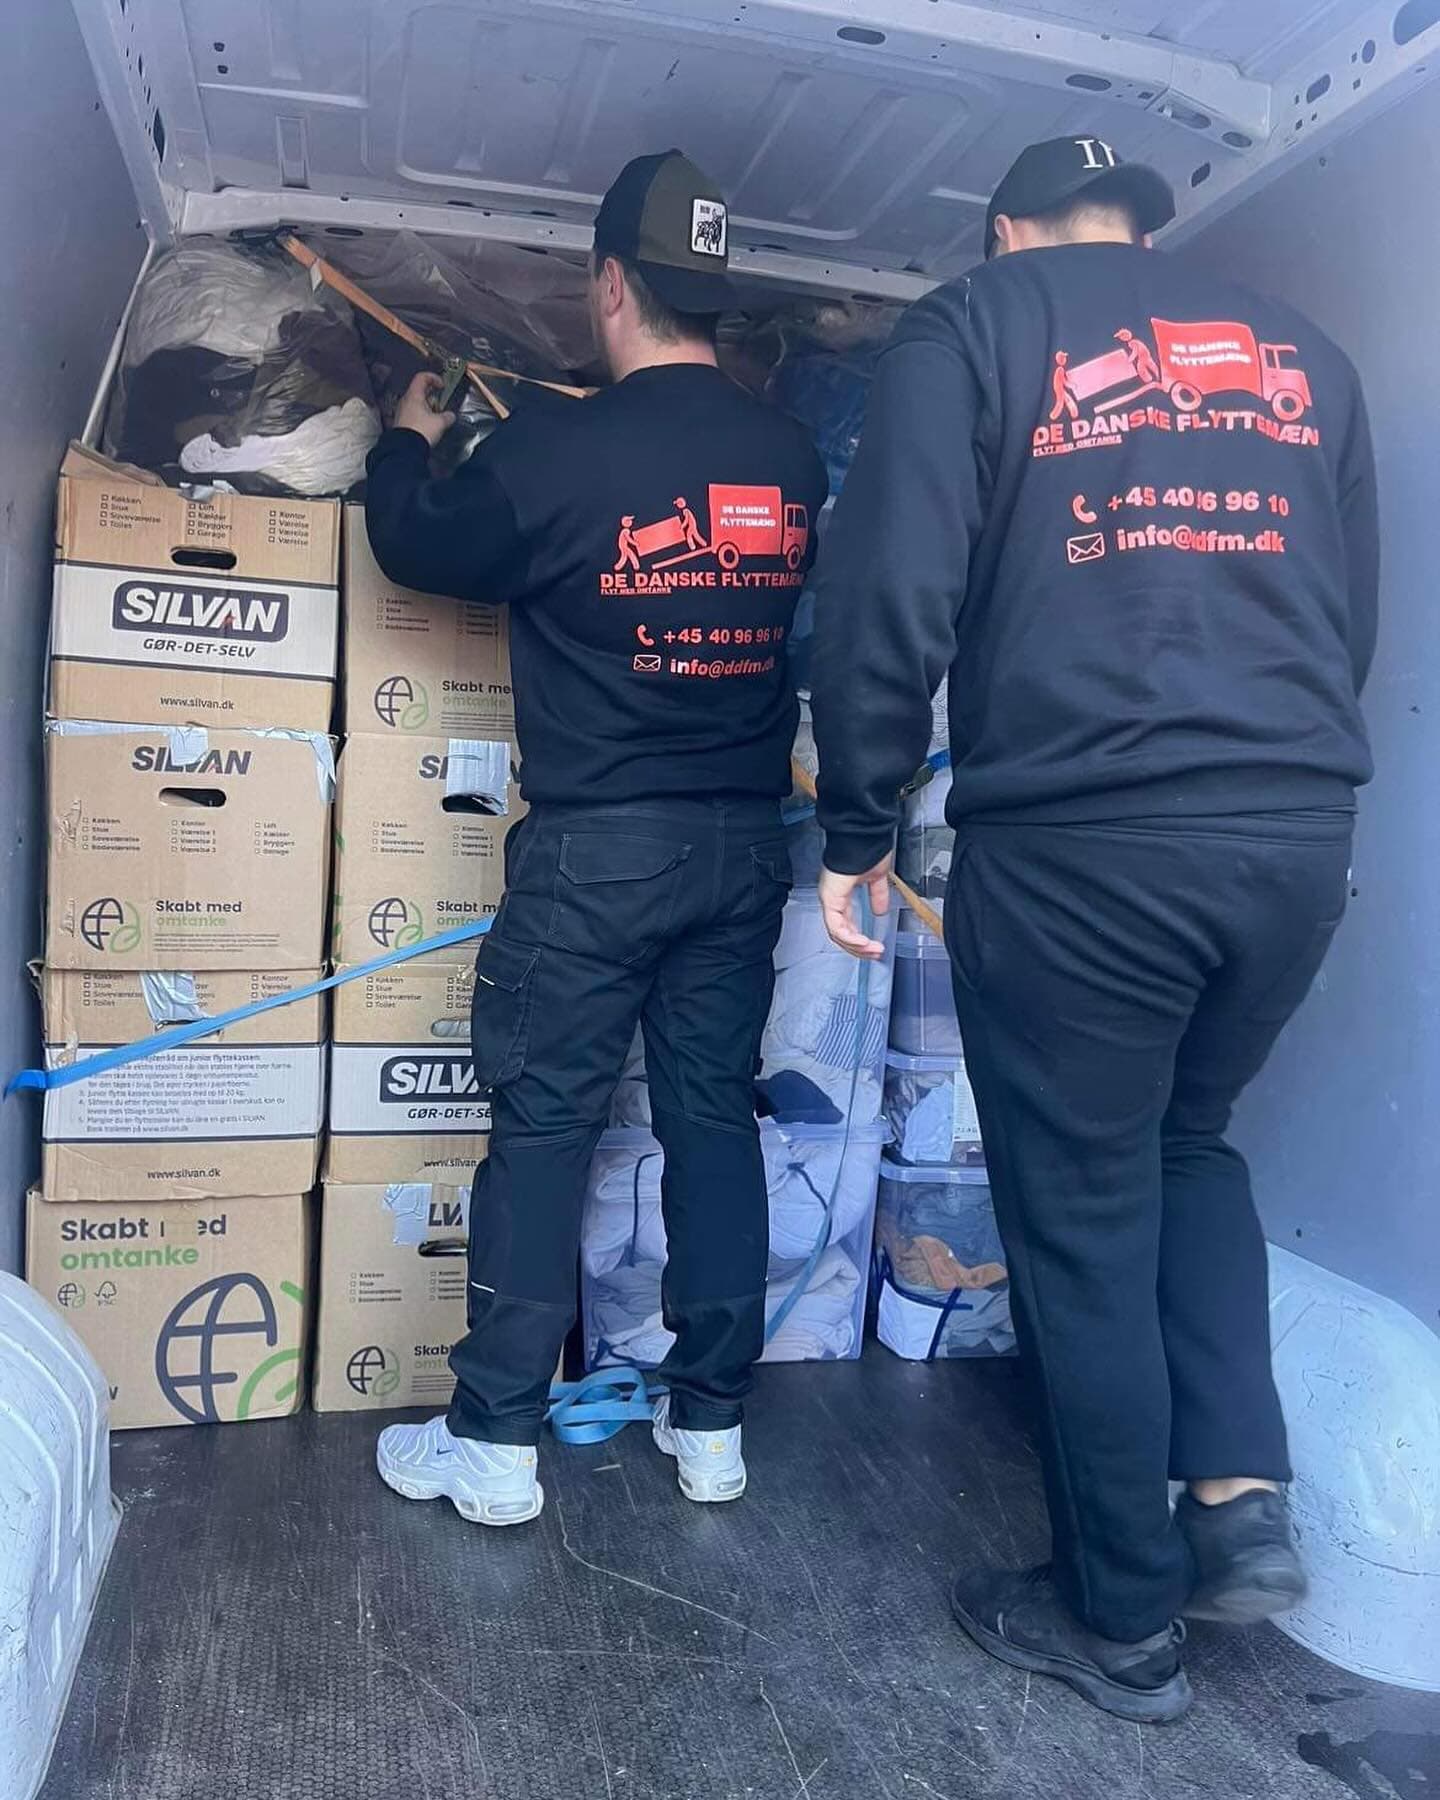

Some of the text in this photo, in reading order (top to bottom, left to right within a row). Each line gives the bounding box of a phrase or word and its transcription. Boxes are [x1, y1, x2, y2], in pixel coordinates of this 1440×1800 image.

[1033, 406, 1319, 446] DE DANSKE FLYTTEMÆN
[1107, 486, 1156, 511] +45
[1162, 487, 1194, 507] 40
[1225, 490, 1260, 511] 96
[1268, 494, 1290, 516] 10
[600, 573, 628, 588] DE
[635, 571, 716, 587] DANSKE
[121, 587, 281, 633] SILVAN
[663, 628, 702, 644] +45
[709, 628, 730, 644] 40
[734, 628, 752, 644] 96
[755, 628, 770, 642] 96
[143, 638, 256, 658] GØR-DET-SELV
[442, 680, 511, 694] Skabt me
[160, 696, 234, 710] www.silvan.dk
[156, 900, 242, 913] Skabt med
[437, 900, 478, 912] Skabt
[157, 915, 227, 927] omtanke
[437, 917, 475, 925] omta
[387, 1062, 481, 1095] SILV
[407, 1108, 492, 1119] GØR-DET-SE
[423, 1157, 477, 1168] www.silvan
[147, 1168, 221, 1179] www.silvan.dk
[61, 1217, 149, 1241] Skabt
[60, 1244, 199, 1270] omtanke
